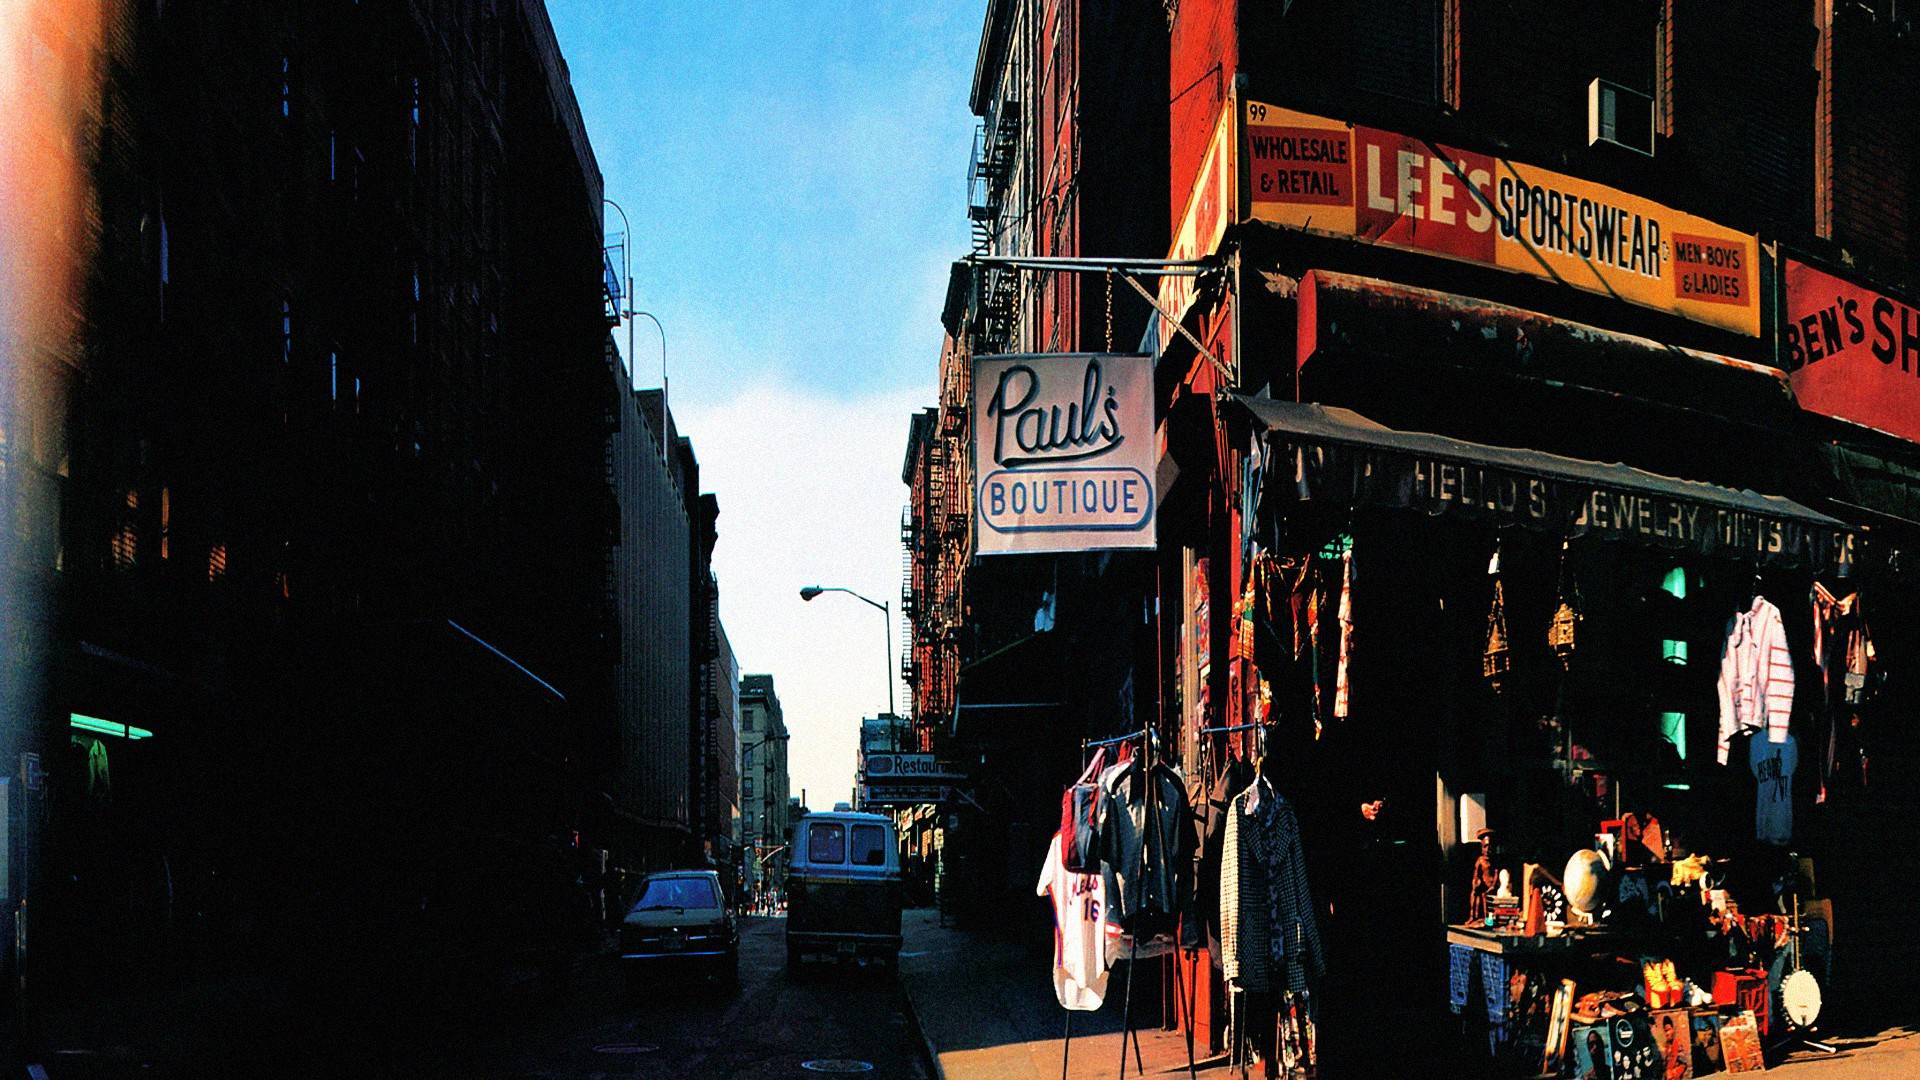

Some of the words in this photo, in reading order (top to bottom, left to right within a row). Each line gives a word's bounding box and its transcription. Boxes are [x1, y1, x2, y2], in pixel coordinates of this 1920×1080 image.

[1250, 104, 1267, 121] 99
[1252, 136, 1347, 164] WHOLESALE
[1260, 172, 1274, 193] &
[1278, 169, 1339, 196] RETAIL
[1367, 143, 1492, 233] LEE'S
[1500, 176, 1661, 280] SPORTSWEAR
[1706, 245, 1740, 269] BOYS
[1783, 295, 1865, 370] BEN'S
[987, 358, 1125, 468] Paul's
[990, 479, 1139, 516] BOUTIQUE
[1084, 897, 1101, 923] 16
